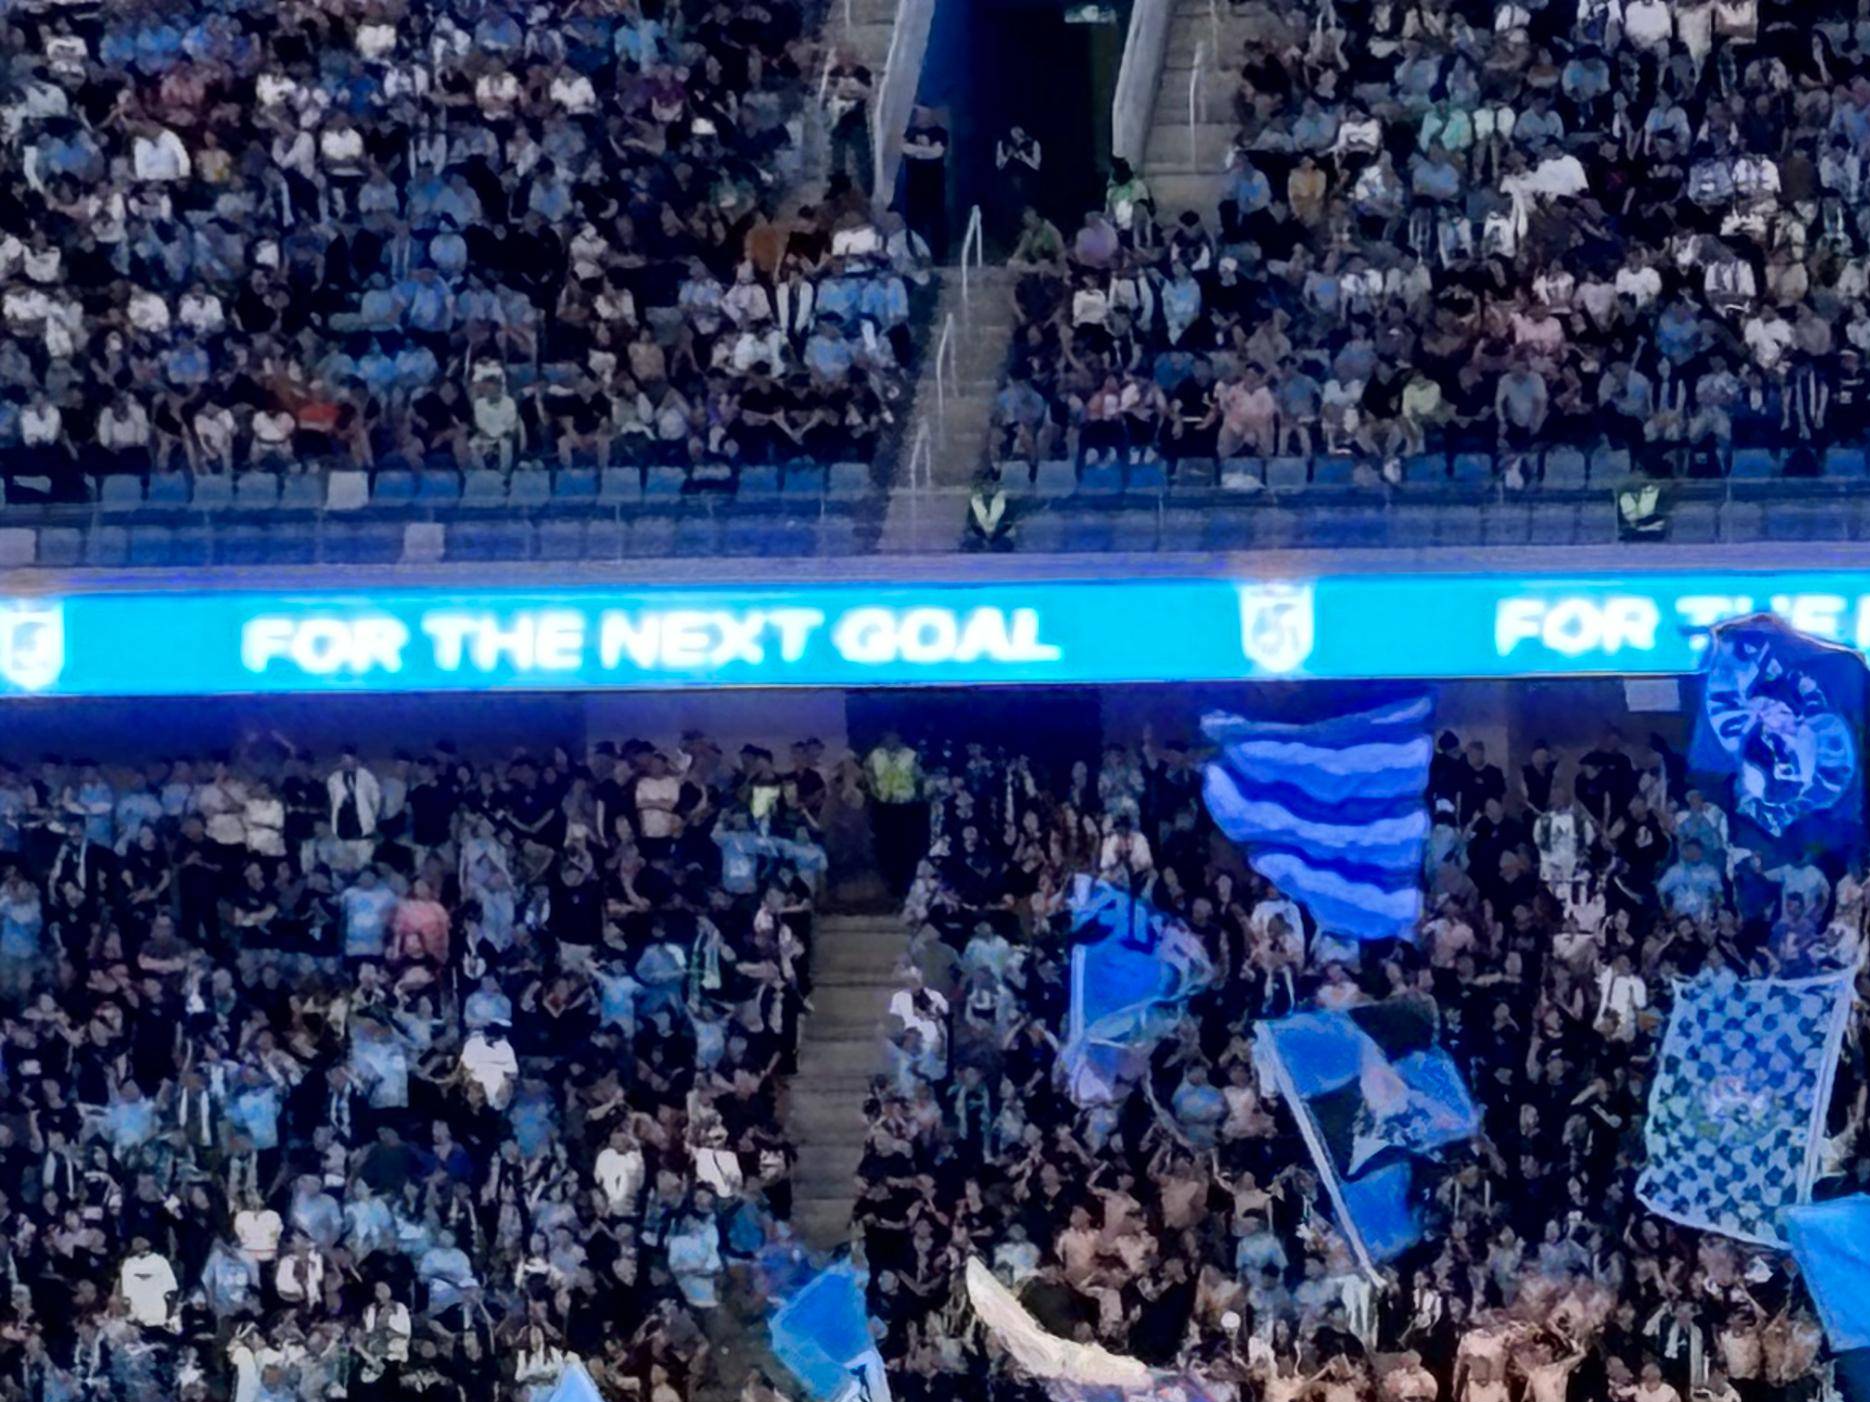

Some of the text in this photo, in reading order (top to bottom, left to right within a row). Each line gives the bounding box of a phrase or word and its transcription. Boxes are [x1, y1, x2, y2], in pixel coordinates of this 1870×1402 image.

[242, 607, 1062, 673] FOR THE NEXT GOAL
[1495, 596, 1661, 656] FOR
